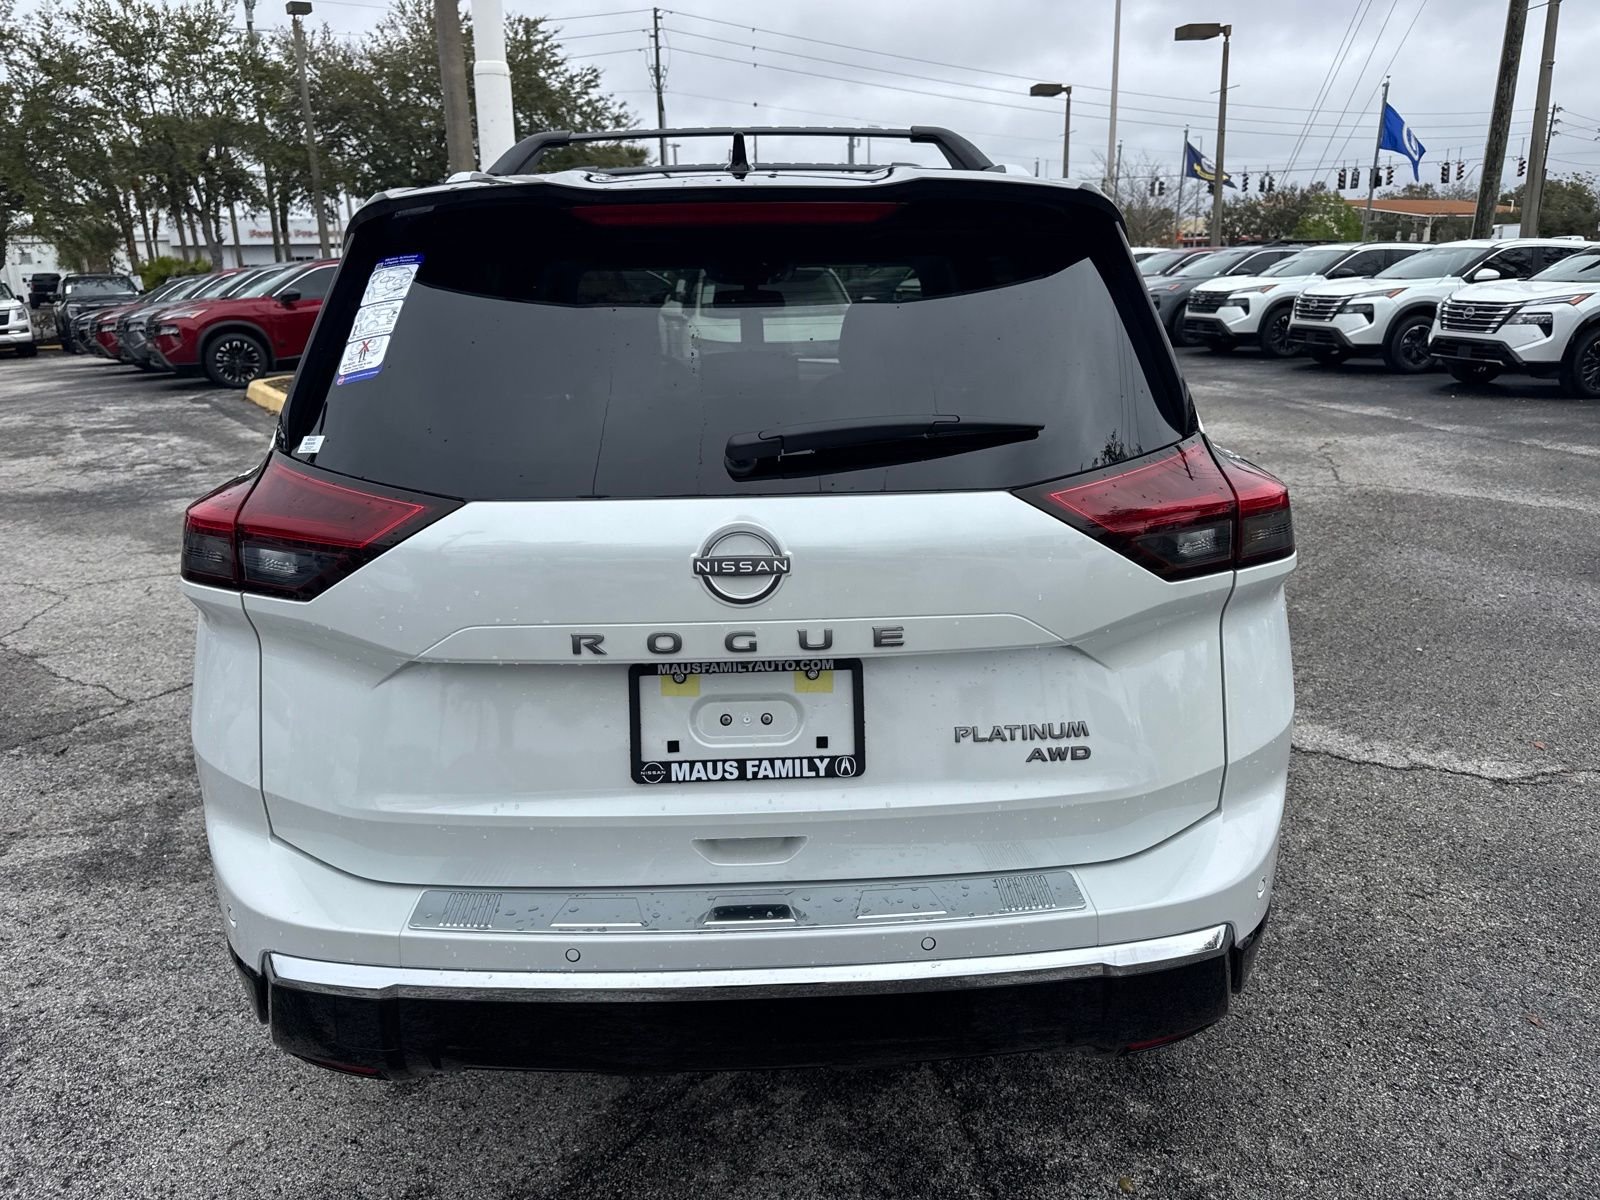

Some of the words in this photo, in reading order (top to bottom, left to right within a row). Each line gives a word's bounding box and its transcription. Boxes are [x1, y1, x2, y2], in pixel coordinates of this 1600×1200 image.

[696, 560, 788, 573] NISSAN
[571, 626, 904, 655] ROGUE
[657, 659, 834, 675] MAUSFAMILYAUTO.COM
[954, 721, 1090, 743] PLATINUM
[1025, 746, 1092, 762] AWD
[671, 761, 739, 781] MAUS
[746, 758, 830, 779] FAMILY
